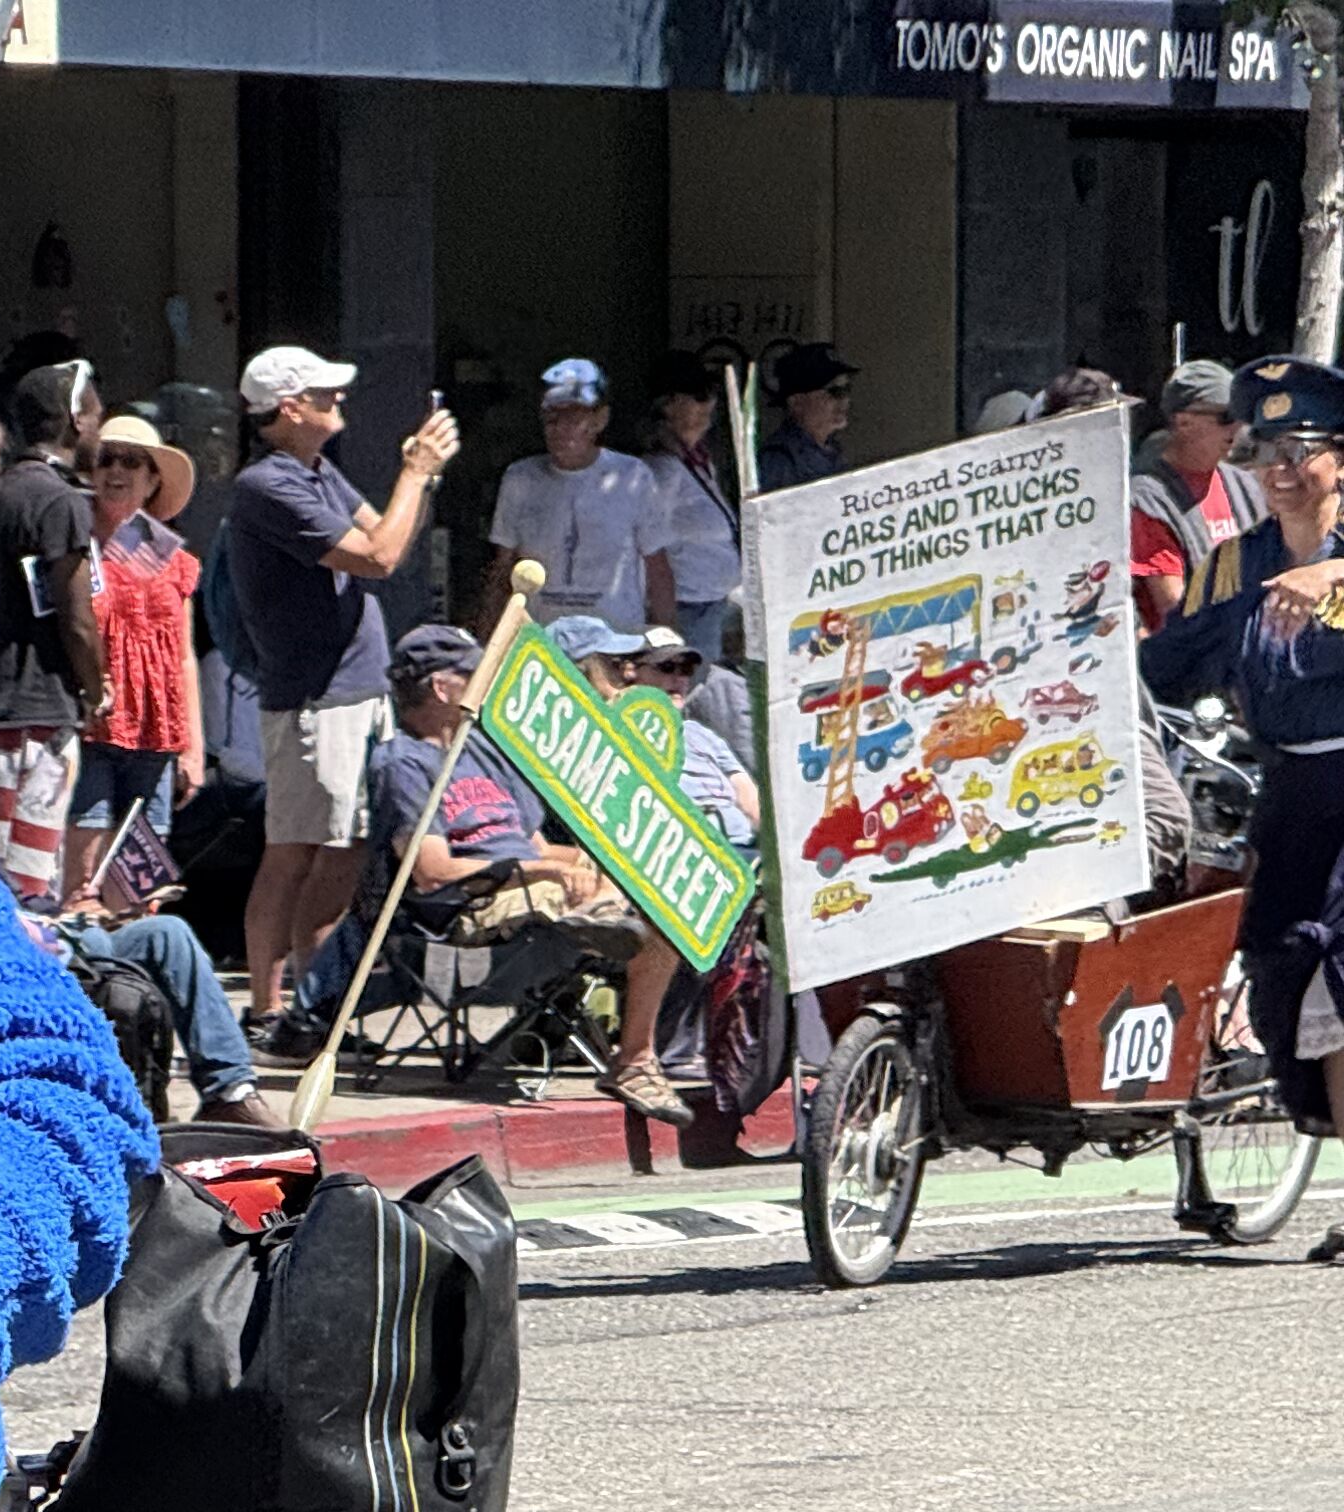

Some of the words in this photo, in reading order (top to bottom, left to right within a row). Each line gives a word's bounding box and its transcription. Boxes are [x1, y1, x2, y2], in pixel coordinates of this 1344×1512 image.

[896, 20, 1005, 73] TOMO'S
[1017, 23, 1148, 79] ORGANIC
[1159, 30, 1216, 80] NAIL
[1229, 31, 1278, 81] SPA
[821, 515, 896, 556] CARS
[901, 498, 960, 538] AND
[964, 467, 1082, 517] TRUCKS
[840, 469, 952, 517] Richard
[957, 440, 1065, 486] Scarry's
[807, 558, 866, 598] AND
[976, 507, 1049, 550] THAT
[1055, 496, 1097, 529] GO
[639, 709, 668, 751] 123
[505, 659, 631, 825] SESAME
[615, 785, 735, 937] STREET
[1109, 1015, 1167, 1080] 108
